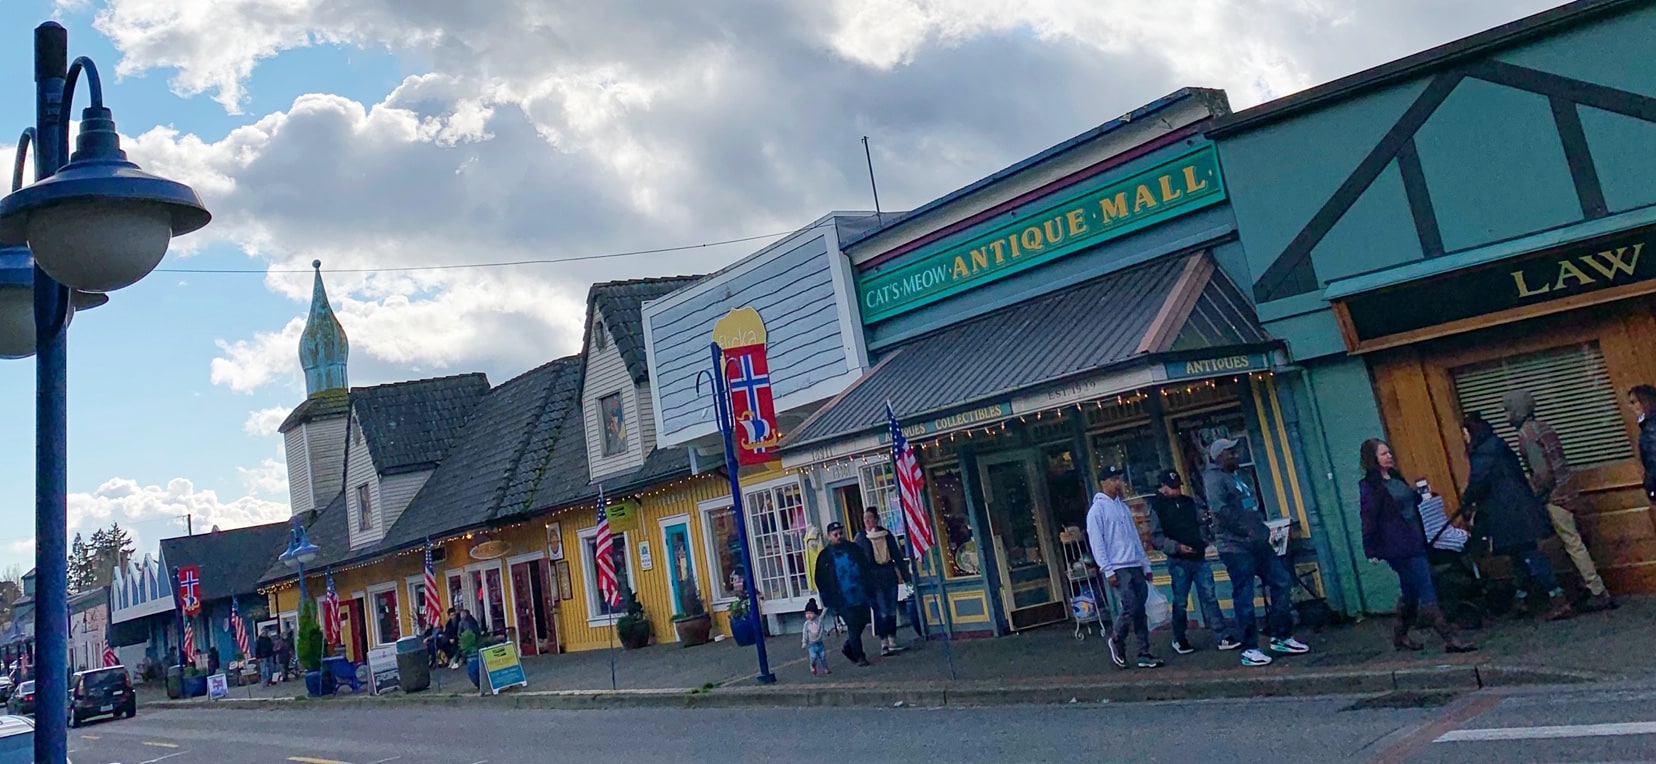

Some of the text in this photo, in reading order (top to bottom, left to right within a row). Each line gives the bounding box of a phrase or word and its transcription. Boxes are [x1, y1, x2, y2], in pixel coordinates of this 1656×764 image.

[903, 264, 947, 296] MEOW
[952, 207, 1087, 281] ANTIQUE
[1099, 165, 1207, 224] MALL
[1510, 242, 1645, 298] LAW
[1186, 355, 1249, 374] ANTIQUES
[935, 404, 1002, 430] COLLECTIBLES
